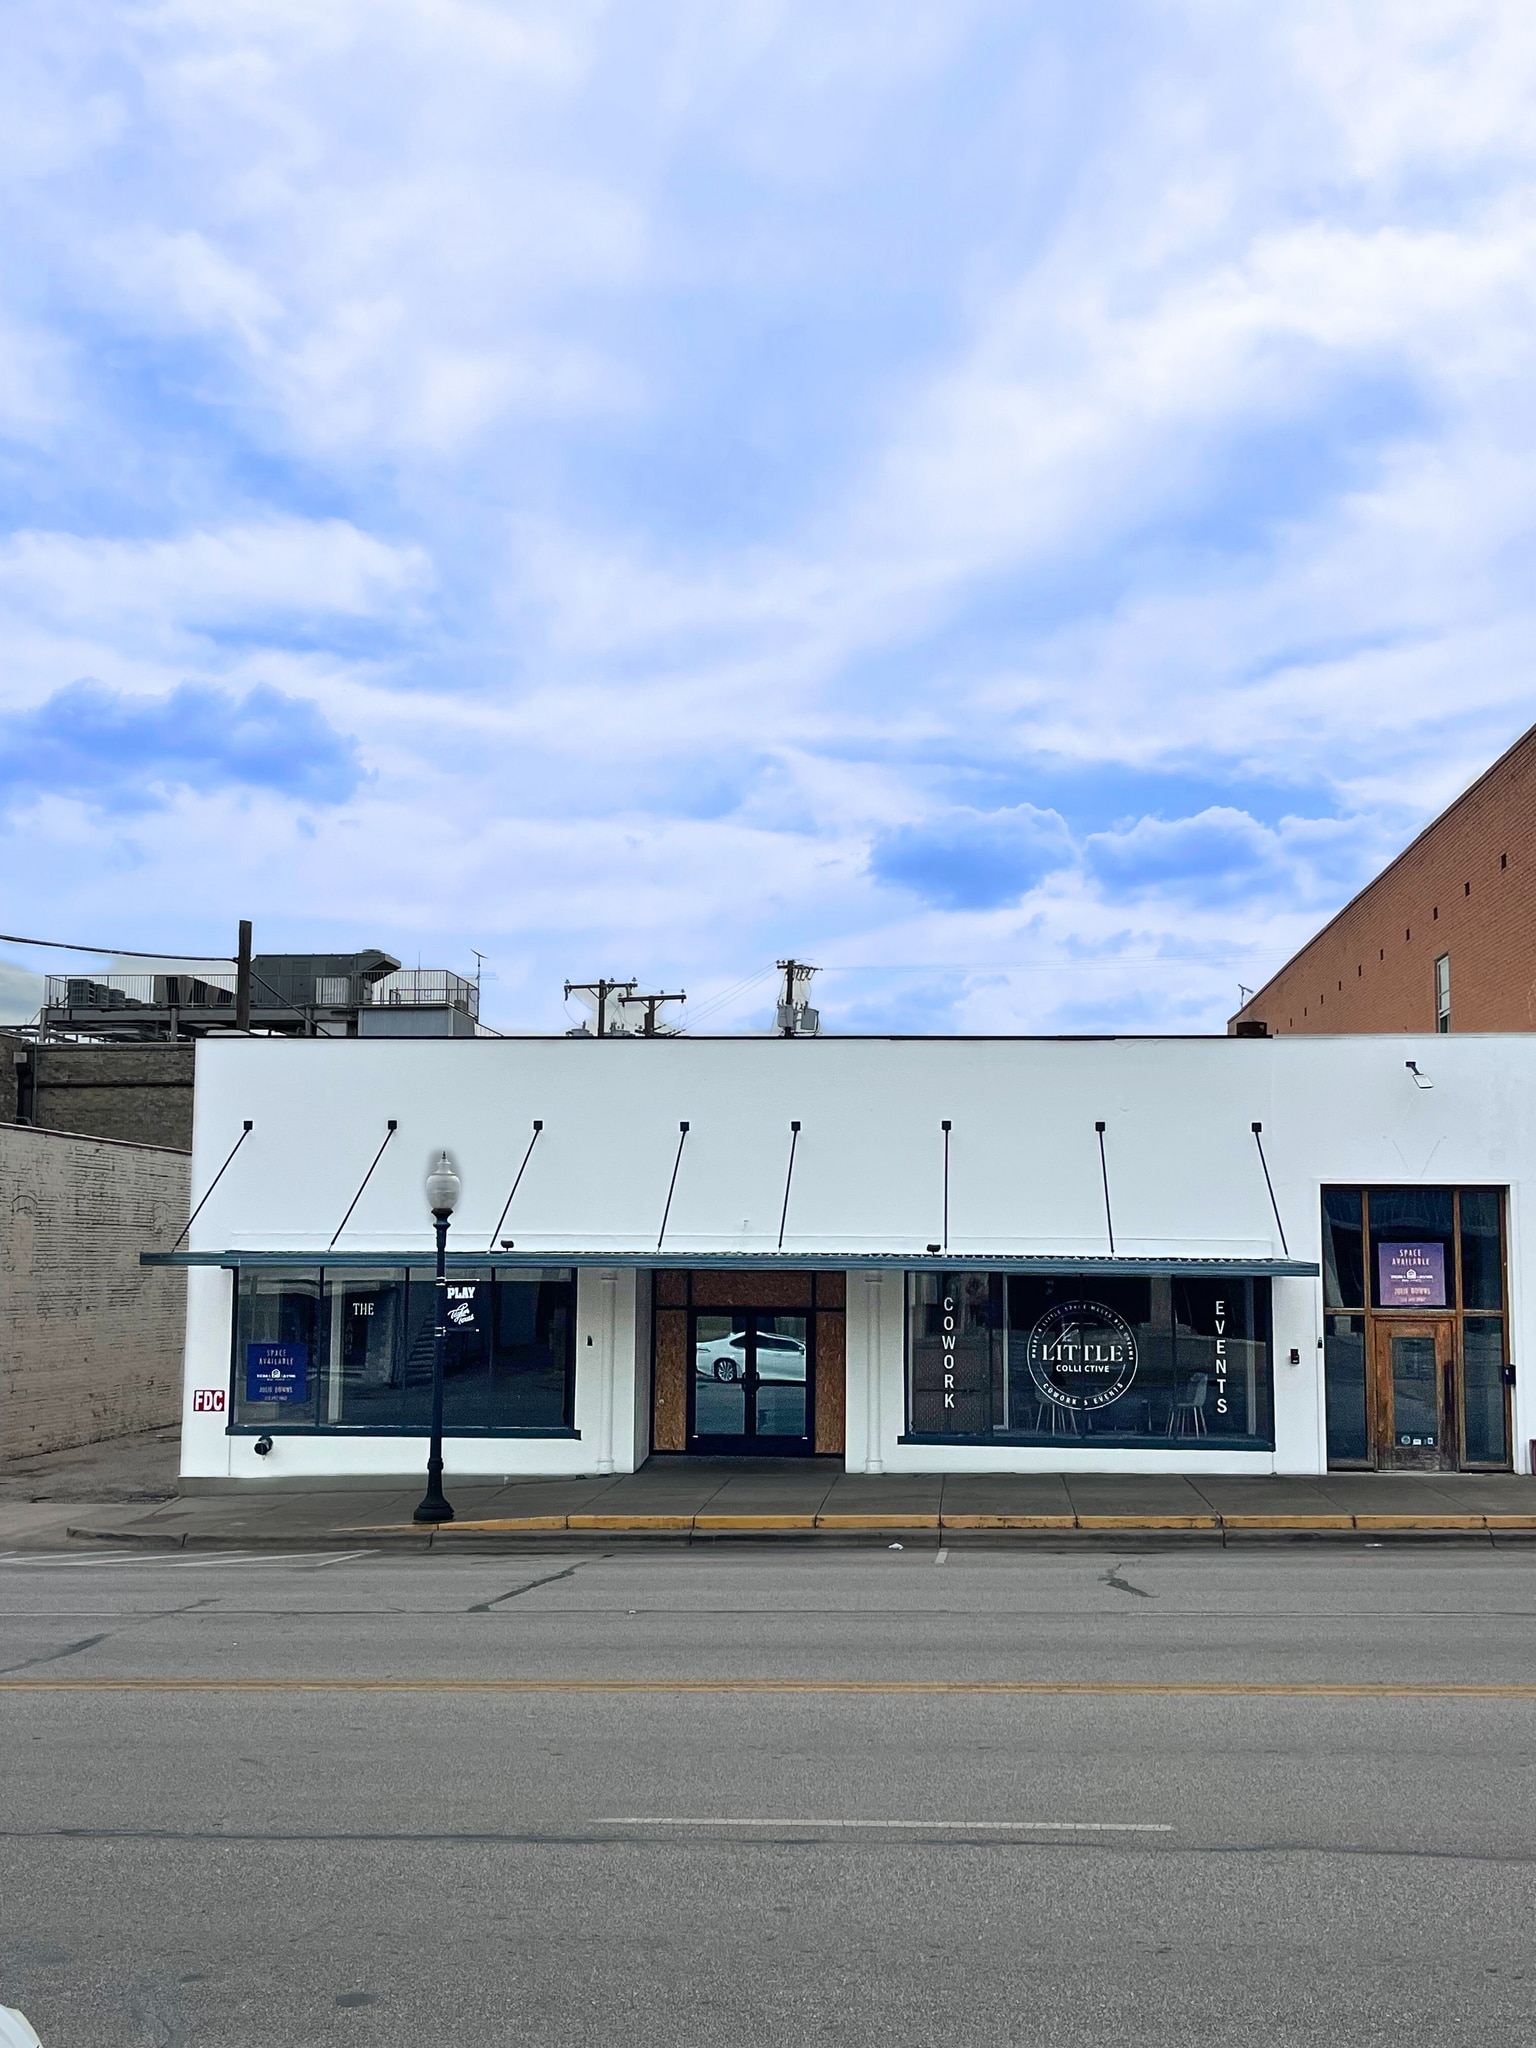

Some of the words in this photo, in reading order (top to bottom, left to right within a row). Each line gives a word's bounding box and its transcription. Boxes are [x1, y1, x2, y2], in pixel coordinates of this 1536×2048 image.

[1399, 1249, 1421, 1257] SPACE
[1391, 1258, 1430, 1266] AVAILABLE
[447, 1286, 476, 1299] PLAY
[352, 1302, 375, 1315] THE
[447, 1302, 470, 1323] Taylor
[266, 1349, 287, 1357] SPACE
[942, 1297, 955, 1408] COWORK
[1042, 1344, 1124, 1362] LITTLE
[1215, 1300, 1228, 1414] EVENTS
[258, 1357, 294, 1366] AVAILABLE
[195, 1391, 224, 1411] FDC
[1042, 1382, 1077, 1405] COWORK
[1093, 1382, 1124, 1405] EVENTS
